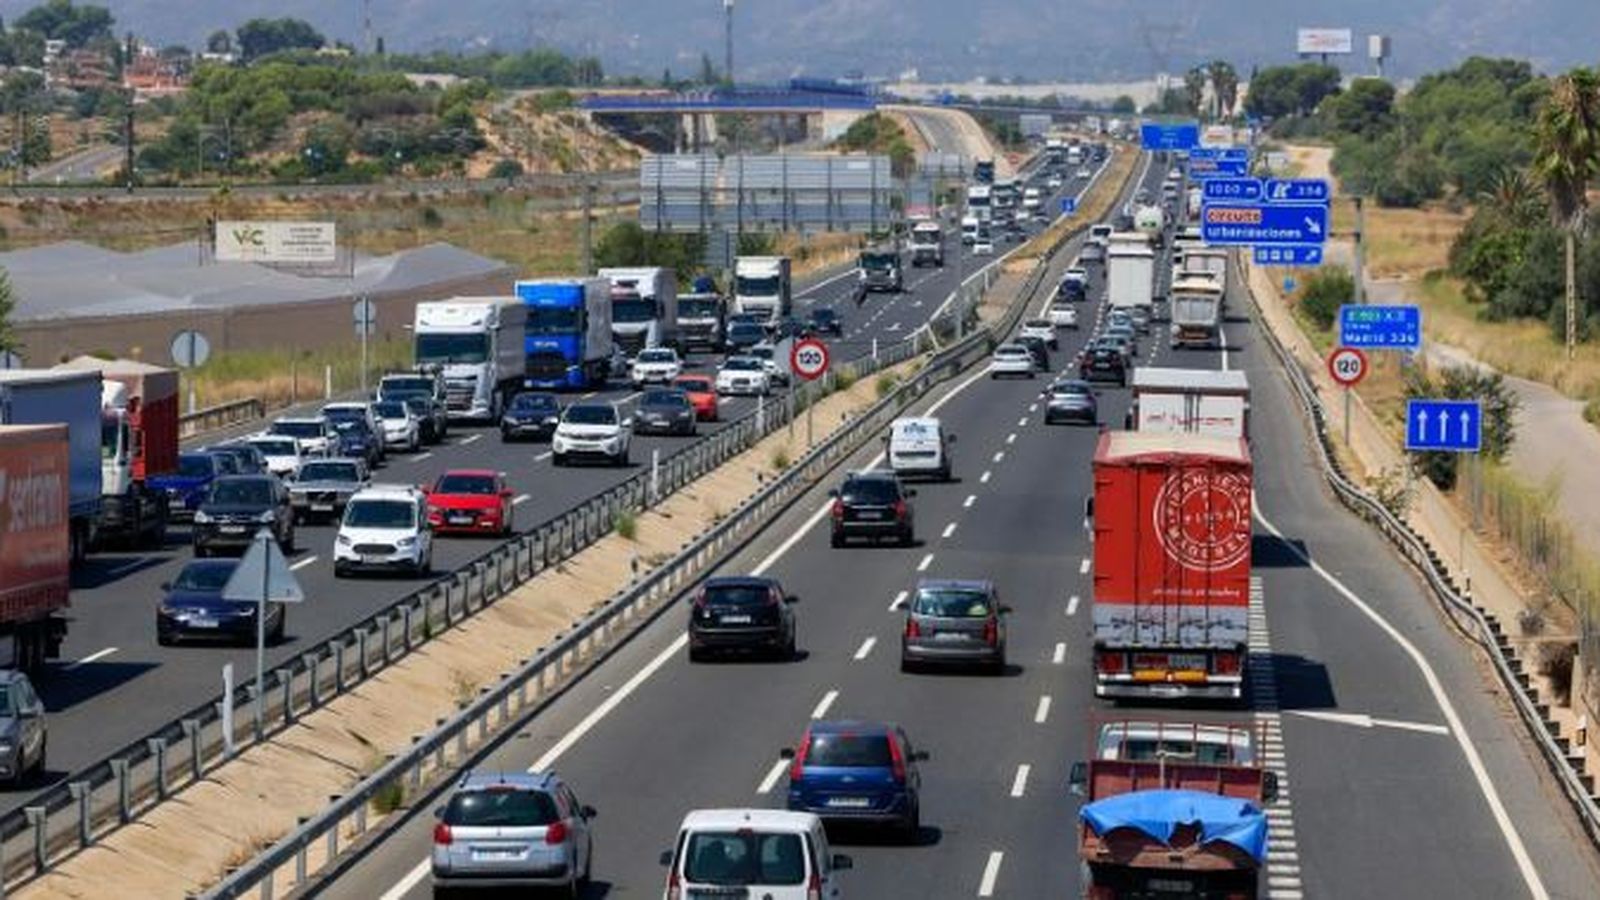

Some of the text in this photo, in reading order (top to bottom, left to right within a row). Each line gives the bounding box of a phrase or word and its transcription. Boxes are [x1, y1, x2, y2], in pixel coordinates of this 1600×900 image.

[1208, 183, 1241, 194] 1000
[1208, 209, 1260, 222] circuito
[1345, 333, 1385, 343] Madrid
[799, 351, 821, 365] 120
[1337, 360, 1359, 374] 120
